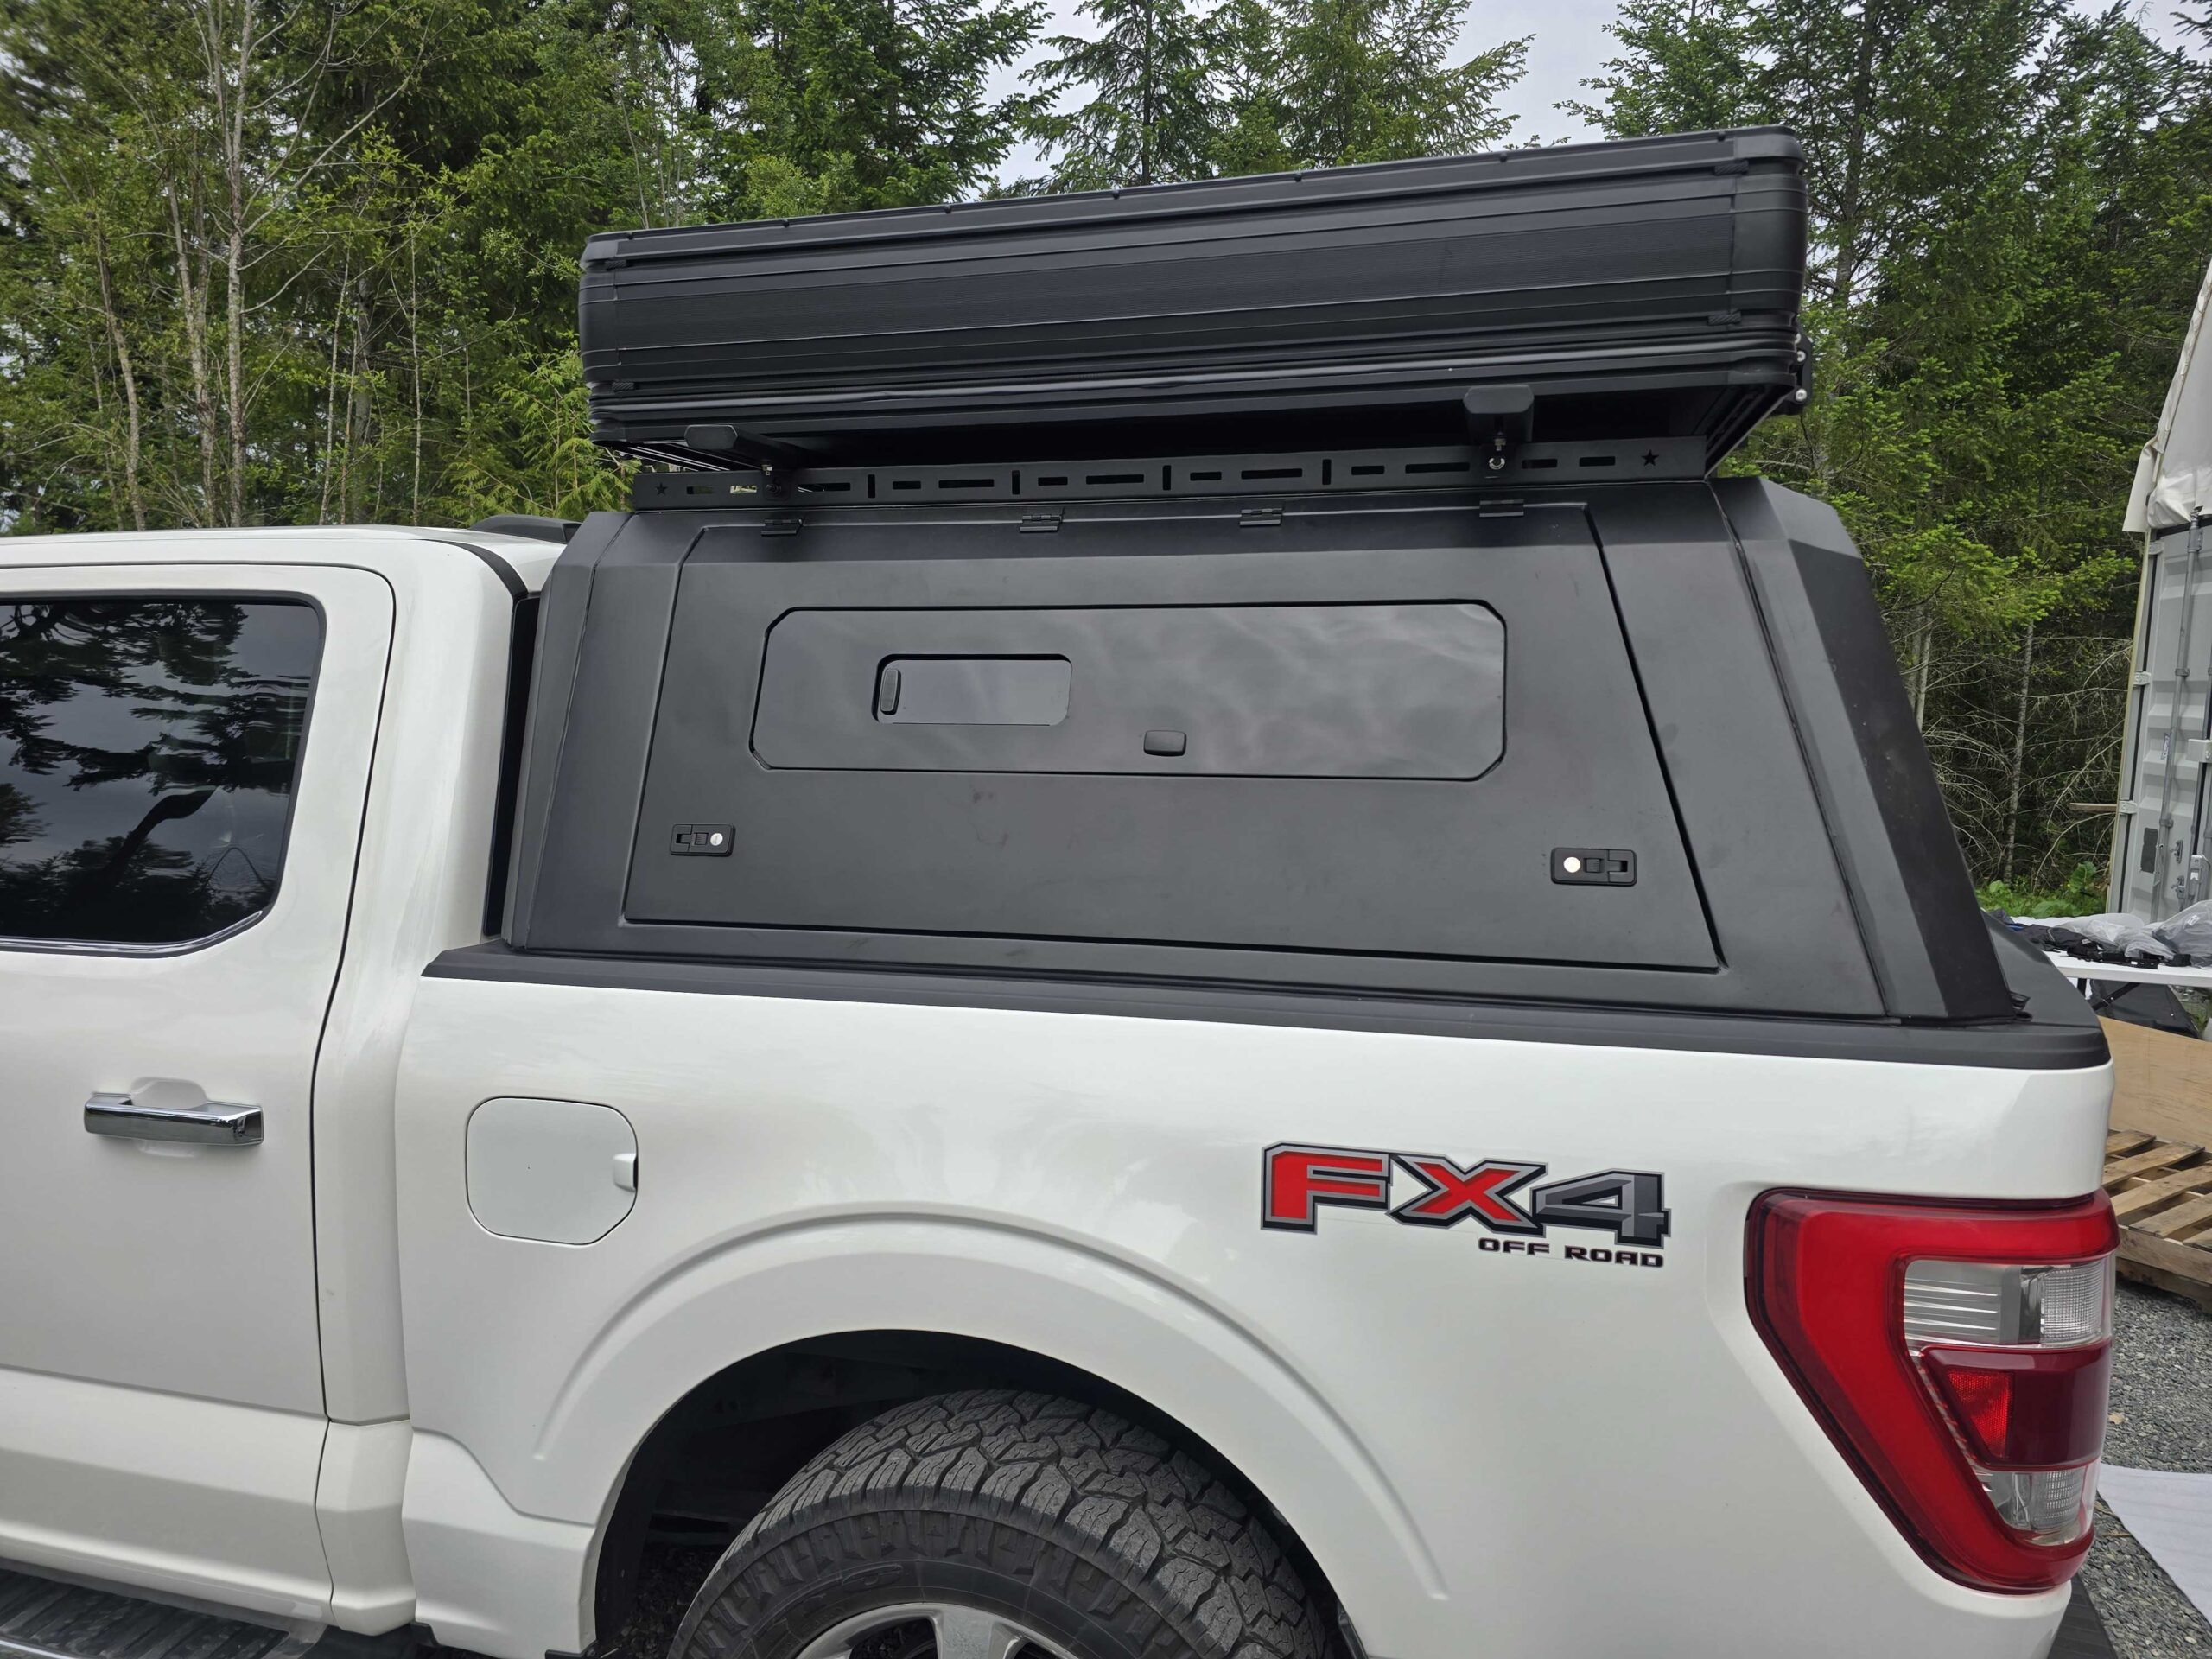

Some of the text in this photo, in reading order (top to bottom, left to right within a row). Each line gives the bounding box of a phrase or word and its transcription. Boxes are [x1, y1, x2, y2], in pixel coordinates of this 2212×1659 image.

[1261, 1141, 1671, 1249] FX4
[1478, 1237, 1664, 1268] OFF ROAD
